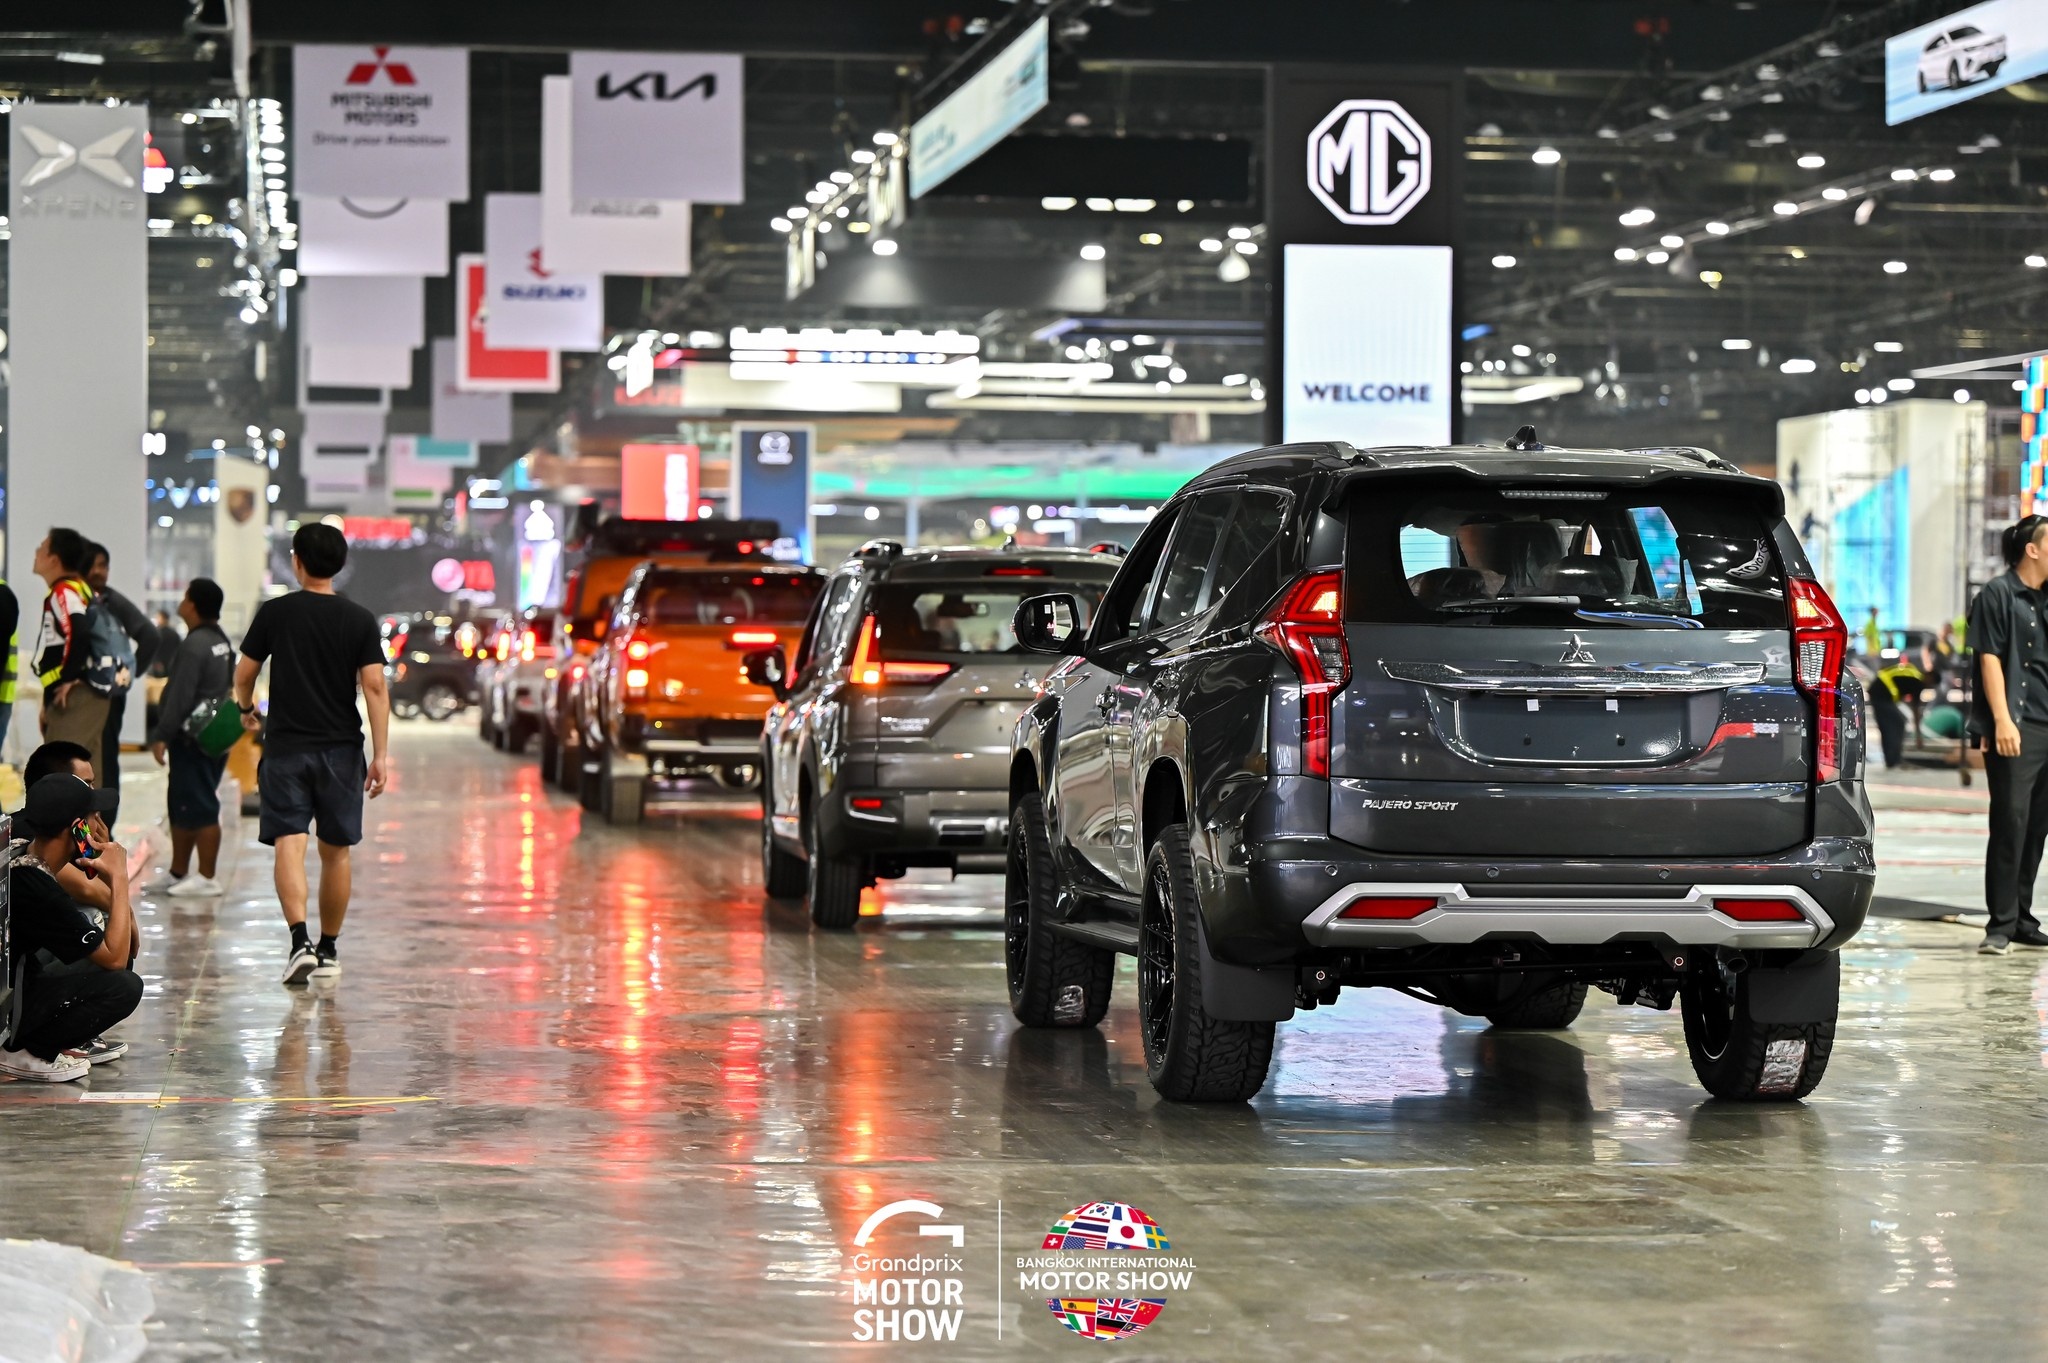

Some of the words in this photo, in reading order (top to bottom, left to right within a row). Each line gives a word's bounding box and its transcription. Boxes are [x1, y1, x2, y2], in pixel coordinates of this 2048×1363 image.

[597, 71, 716, 100] KIA
[331, 92, 432, 107] MITSUBISHI
[344, 112, 419, 126] MOTORS
[1317, 110, 1421, 214] MG
[504, 284, 586, 300] SUZUKI
[1303, 383, 1430, 402] WELCOME
[1362, 799, 1412, 810] PAJERO
[1414, 801, 1459, 811] SPORT
